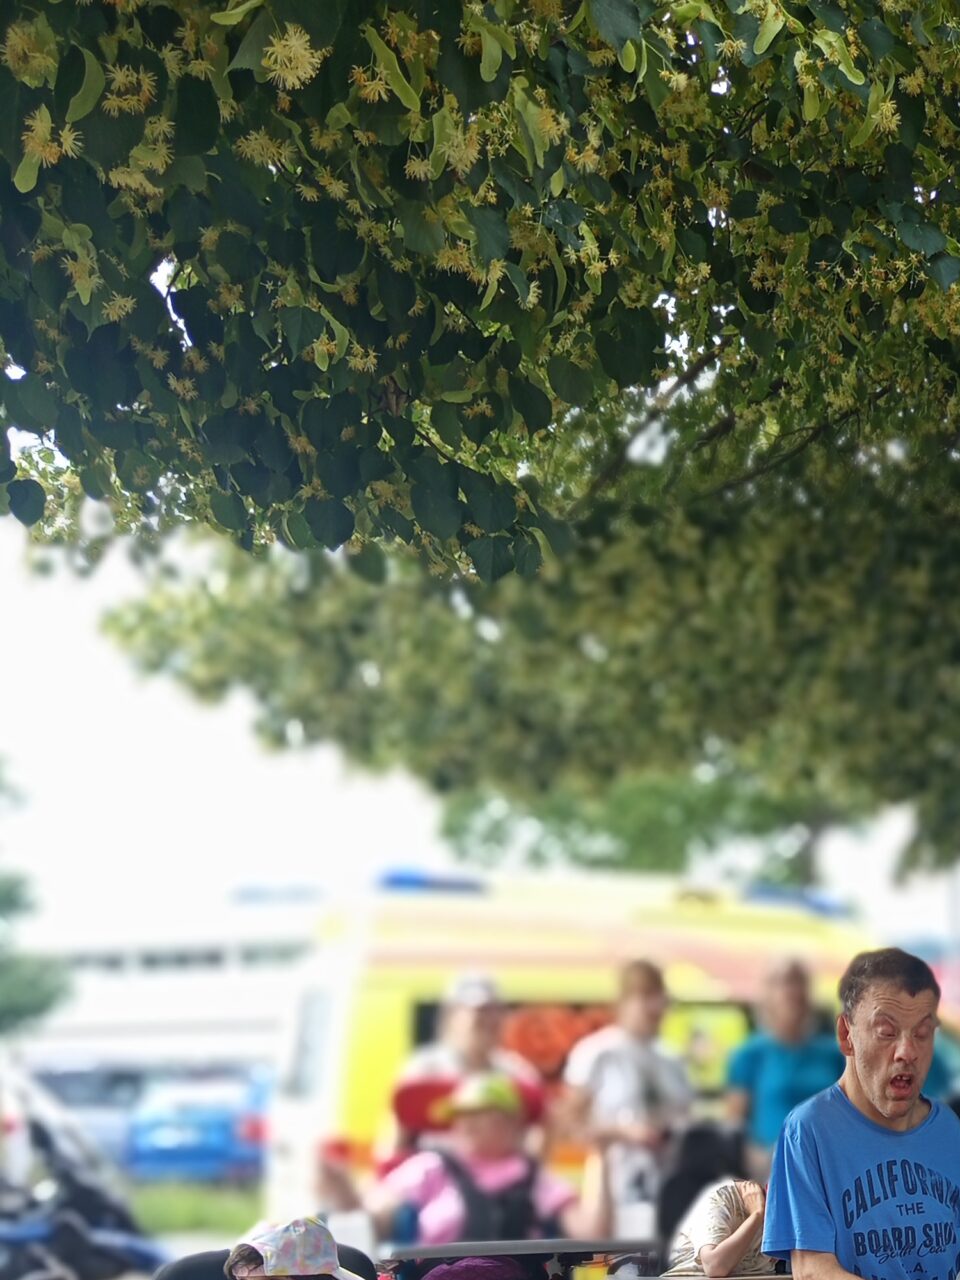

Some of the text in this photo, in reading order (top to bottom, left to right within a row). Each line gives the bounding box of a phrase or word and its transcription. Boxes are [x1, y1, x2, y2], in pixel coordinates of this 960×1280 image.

[842, 1159, 960, 1229] CALIFORNIA
[896, 1202, 925, 1216] THE
[853, 1226, 917, 1257] BOARD
